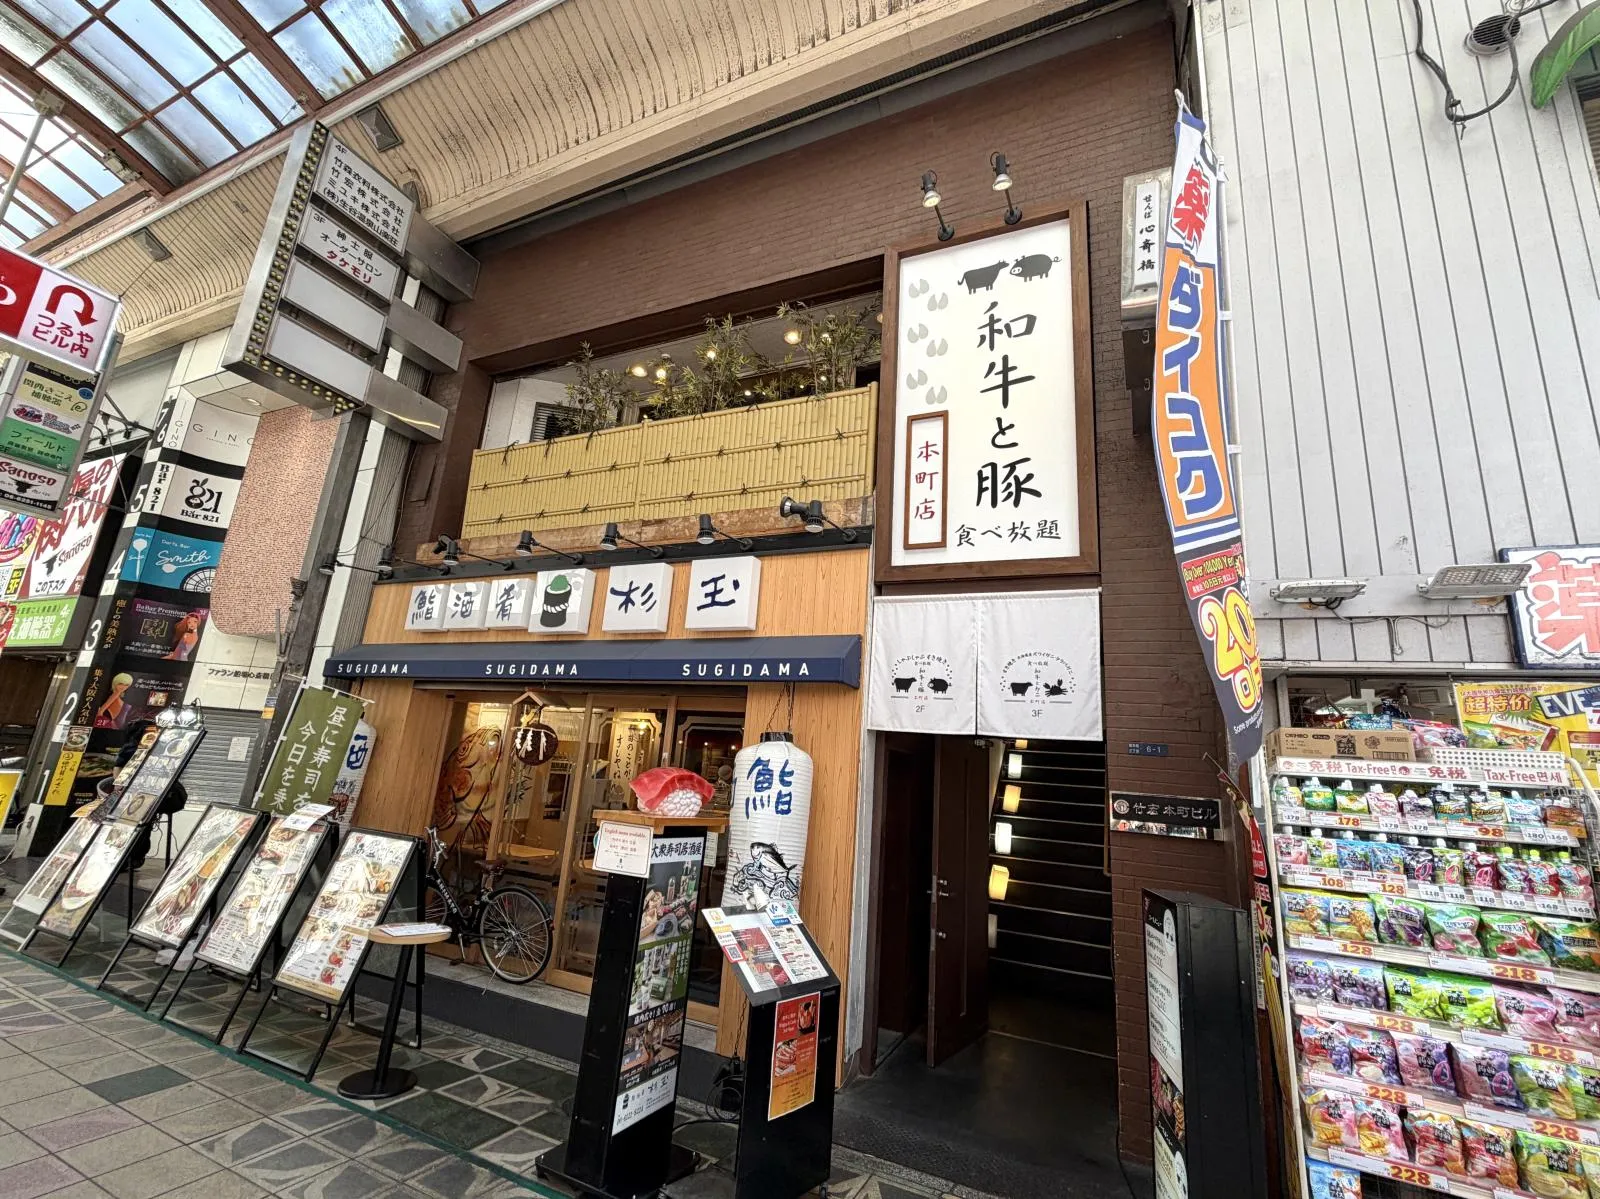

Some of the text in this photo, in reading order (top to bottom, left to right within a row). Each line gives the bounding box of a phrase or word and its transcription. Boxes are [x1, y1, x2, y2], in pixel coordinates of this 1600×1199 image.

[313, 213, 326, 224] 3F
[320, 232, 382, 277] オーダーサロン
[326, 250, 372, 284] タケモリ
[38, 313, 94, 344] つるや
[32, 325, 89, 359] ビル内
[1163, 262, 1225, 521] ダイコク
[976, 301, 1043, 509] 和牛と豚
[155, 408, 167, 428] 7
[10, 430, 66, 453] フィールド
[157, 430, 167, 443] 6
[914, 441, 941, 521] 本町店
[130, 484, 148, 513] 5
[202, 513, 220, 523] 821
[953, 519, 1062, 548] 食べ放題
[107, 549, 126, 579] 4
[85, 620, 101, 651] 3
[337, 662, 409, 675] SUGIDAMA
[485, 663, 579, 677] SUGIDAMA
[682, 661, 810, 678] SUGIDAMA
[59, 692, 78, 726] 2
[915, 705, 925, 713] 2F
[1464, 694, 1533, 714] 超特价
[1031, 709, 1044, 718] 3F
[1309, 760, 1389, 775] 免税 Tax-Free
[1427, 766, 1562, 784] 免税 Tax-Free 면세
[37, 769, 51, 804] 1
[1132, 802, 1217, 820] 竹宏本町ビル
[1338, 817, 1360, 827] 178
[1478, 827, 1505, 837] 98
[1322, 877, 1345, 888] 108
[1381, 883, 1405, 894] 128
[1341, 943, 1373, 956] 128
[1494, 965, 1537, 981] 218
[1376, 1016, 1414, 1032] 128
[1530, 1043, 1575, 1062] 128
[1368, 1086, 1407, 1104] 228
[1534, 1121, 1580, 1141] 228
[1389, 1165, 1431, 1185] 228
